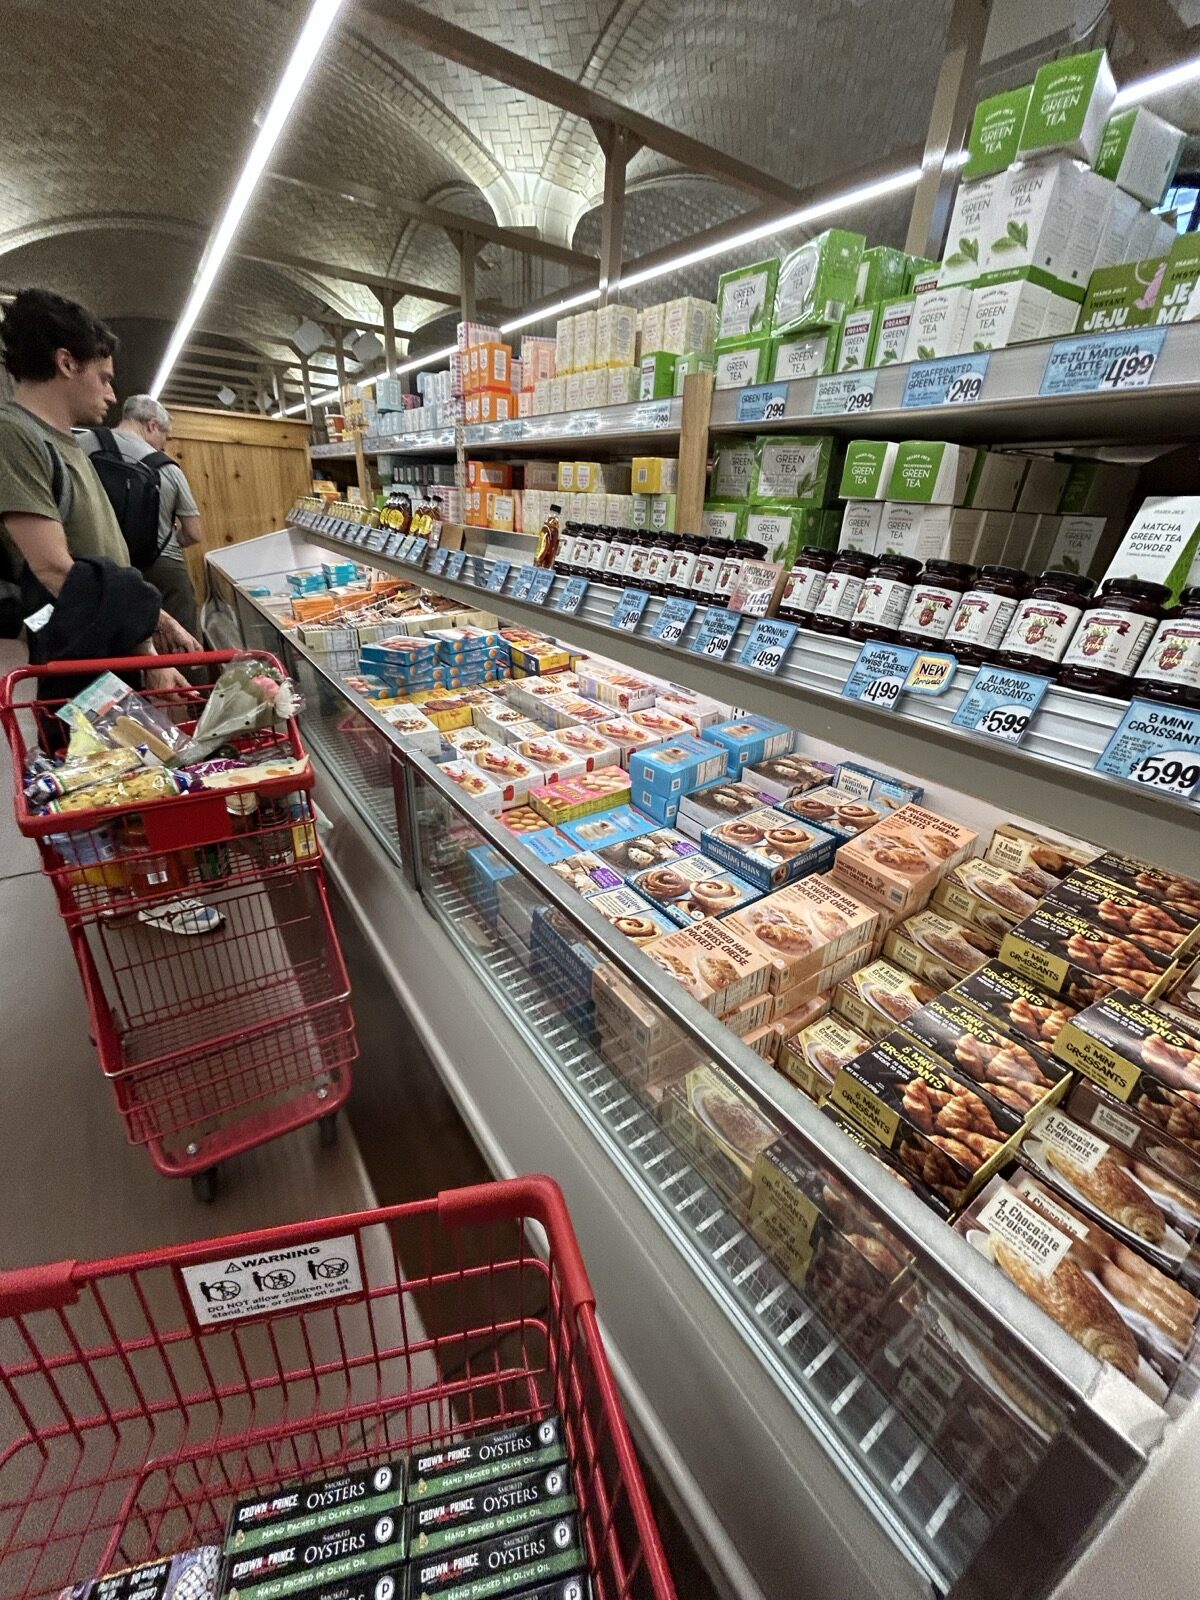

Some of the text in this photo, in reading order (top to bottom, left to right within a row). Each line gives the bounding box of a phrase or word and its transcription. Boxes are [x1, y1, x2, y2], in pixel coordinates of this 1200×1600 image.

[1040, 94, 1081, 115] GREEN
[1046, 112, 1066, 126] TEA
[980, 124, 1013, 145] GREEN
[984, 142, 1003, 154] TEA
[1010, 178, 1044, 196] GREEN
[961, 199, 991, 217] GREEN
[1014, 194, 1032, 208] TEA
[964, 213, 981, 226] TEA
[733, 285, 756, 300] GREEN
[735, 299, 750, 310] TEA
[976, 305, 1006, 319] GREEN
[919, 312, 946, 325] GREEN
[979, 318, 996, 329] TEA
[1083, 307, 1129, 331] JEJU
[883, 329, 905, 340] GREEN
[922, 324, 938, 335] TEA
[847, 344, 859, 354] TEA
[885, 338, 898, 348] TEA
[788, 351, 814, 363] GREEN
[1052, 344, 1141, 365] JEJU MATCHA
[726, 360, 748, 371] GREEN
[792, 362, 807, 373] TEA
[911, 363, 973, 380] DECAFFEINATED
[1067, 359, 1104, 372] LATTE
[730, 371, 743, 380] TEA
[908, 375, 954, 390] GREEN TEA
[742, 391, 773, 403] GREEN TEA
[818, 385, 841, 396] GREEN
[843, 383, 857, 394] TEA
[775, 454, 805, 464] GREEN
[780, 464, 797, 473] TEA
[851, 466, 876, 476] GREEN
[902, 468, 930, 478] GREEN
[854, 475, 868, 485] TEA
[905, 478, 921, 488] TEA
[709, 519, 727, 528] GREEN
[711, 527, 722, 535] TEA
[757, 523, 780, 533] GREEN
[848, 519, 870, 528] GREEN
[851, 527, 864, 536] TEA
[887, 522, 912, 531] GREEN
[1140, 522, 1182, 532] MATCHA
[761, 532, 774, 542] TEA
[890, 531, 904, 539] TEA
[1130, 532, 1182, 543] GREEN TEA
[1128, 542, 1172, 553] POWDER
[756, 623, 790, 639] MORNING
[756, 633, 780, 647] BUNS
[860, 656, 910, 673] SWISS CHEESE
[869, 651, 891, 662] HAM
[865, 665, 895, 677] POCKETS
[919, 663, 948, 678] NEW
[975, 680, 1036, 702] CROISSANTS
[986, 674, 1031, 691] ALMOND
[981, 709, 1031, 734] $5.99
[1148, 713, 1195, 731] 8 MINI
[1127, 720, 1200, 746] CROISSANT
[1129, 756, 1200, 789] $5.99
[894, 813, 926, 831] POCKETS
[905, 805, 960, 834] UNCURED HAM
[908, 812, 961, 840] SWISS CHEESE
[793, 883, 825, 905] POCKETS
[808, 876, 842, 900] UNCURED
[839, 894, 860, 911] HAM
[1066, 877, 1129, 906] CROISSANTS
[1094, 883, 1118, 895] MINI
[810, 884, 858, 919] SWISS CHEESE
[1035, 909, 1101, 941] CROISSANTS
[1064, 915, 1090, 929] MINI
[684, 927, 716, 952] POCKETS
[702, 919, 753, 959] UNCURED HAM
[703, 929, 750, 968] SWISS CHEESE
[981, 967, 1045, 1006] CROISSANTS
[1011, 975, 1036, 992] MINI
[1103, 997, 1186, 1046] CROISSANTS
[1129, 1003, 1172, 1029] 8 MINI
[880, 1041, 946, 1090] CROISSANTS
[902, 1046, 937, 1072] 8 MINI
[1066, 1042, 1128, 1088] CROISSANTS
[1083, 1045, 1116, 1069] 8 MINI
[841, 1089, 891, 1135] CROISSANTS
[862, 1097, 882, 1114] MINI
[1045, 1123, 1093, 1159] Croissants
[1048, 1116, 1056, 1125] 4
[1056, 1121, 1100, 1154] Chocolate
[995, 1208, 1051, 1258] Croissants
[998, 1198, 1008, 1210] 4
[1008, 1206, 1060, 1252] Chocolate
[241, 1246, 321, 1269] WARNING
[207, 1305, 224, 1314] DO
[227, 1300, 249, 1311] NOT
[251, 1293, 279, 1305] allow
[281, 1284, 322, 1299] children
[323, 1281, 335, 1289] to
[211, 1284, 352, 1320] stand, ride, or climb on cart.
[418, 1436, 532, 1472] CROWN PRINCE OYSTERS
[442, 1456, 536, 1487] HAND PACKED IN OLIVE OIL
[324, 1478, 351, 1490] SMOKED
[238, 1482, 366, 1522] CROWN PRINCE OYSTERS
[482, 1485, 538, 1513] OYSTERS
[262, 1504, 367, 1539] HAND PACKED IN OLIVE OIL
[231, 1533, 366, 1579] CROWN PRINCE OYSTERS
[420, 1538, 546, 1584] CROWN PRINCE OYSTERS
